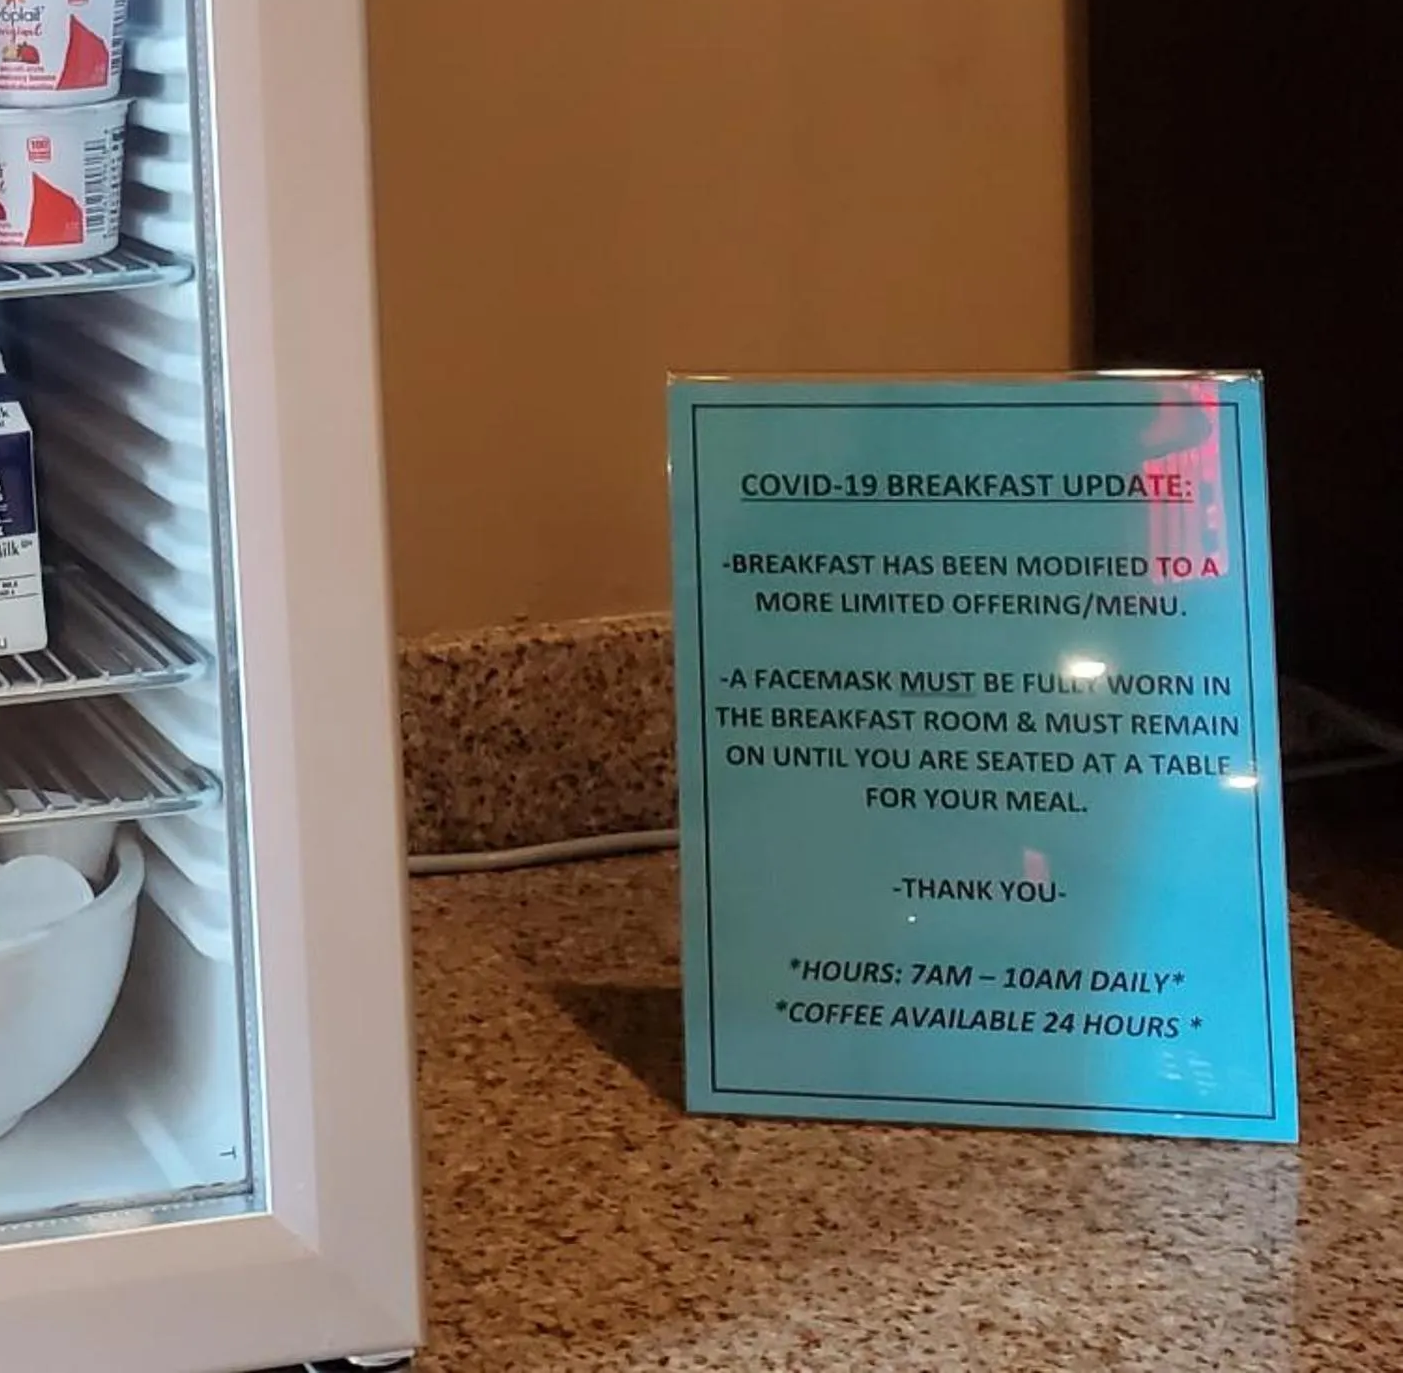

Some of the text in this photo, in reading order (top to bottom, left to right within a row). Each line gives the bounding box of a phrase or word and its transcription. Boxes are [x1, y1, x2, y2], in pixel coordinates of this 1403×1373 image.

[741, 473, 1193, 498] COVID-19 BREAKFAST UPDATE:
[722, 554, 1219, 577] -BREAKFAST HAS BEEN MODIFIED TO A
[755, 592, 1187, 619] MORE LIMITED OFFERING/MENU.
[720, 668, 747, 689] -A
[755, 669, 892, 691] FACEMASK
[900, 671, 976, 693] MUST
[984, 672, 1013, 693] BE
[1107, 674, 1195, 696] WORN
[1203, 676, 1230, 696] IN
[716, 706, 1239, 736] THE BREAKFAST ROOM & MUST REMAIN
[726, 745, 1230, 776] ON UNTIL YOU ARE SEATED AT A TABLE
[866, 787, 1087, 812] FOR YOUR MEAL.
[893, 878, 1067, 902] -THANK YOU-
[910, 964, 973, 987] 7AM
[1002, 967, 1082, 991] 10AM
[890, 1006, 1036, 1032] AVAILABLE
[1042, 1011, 1075, 1034] 24
[1083, 1014, 1180, 1039] HOURS
